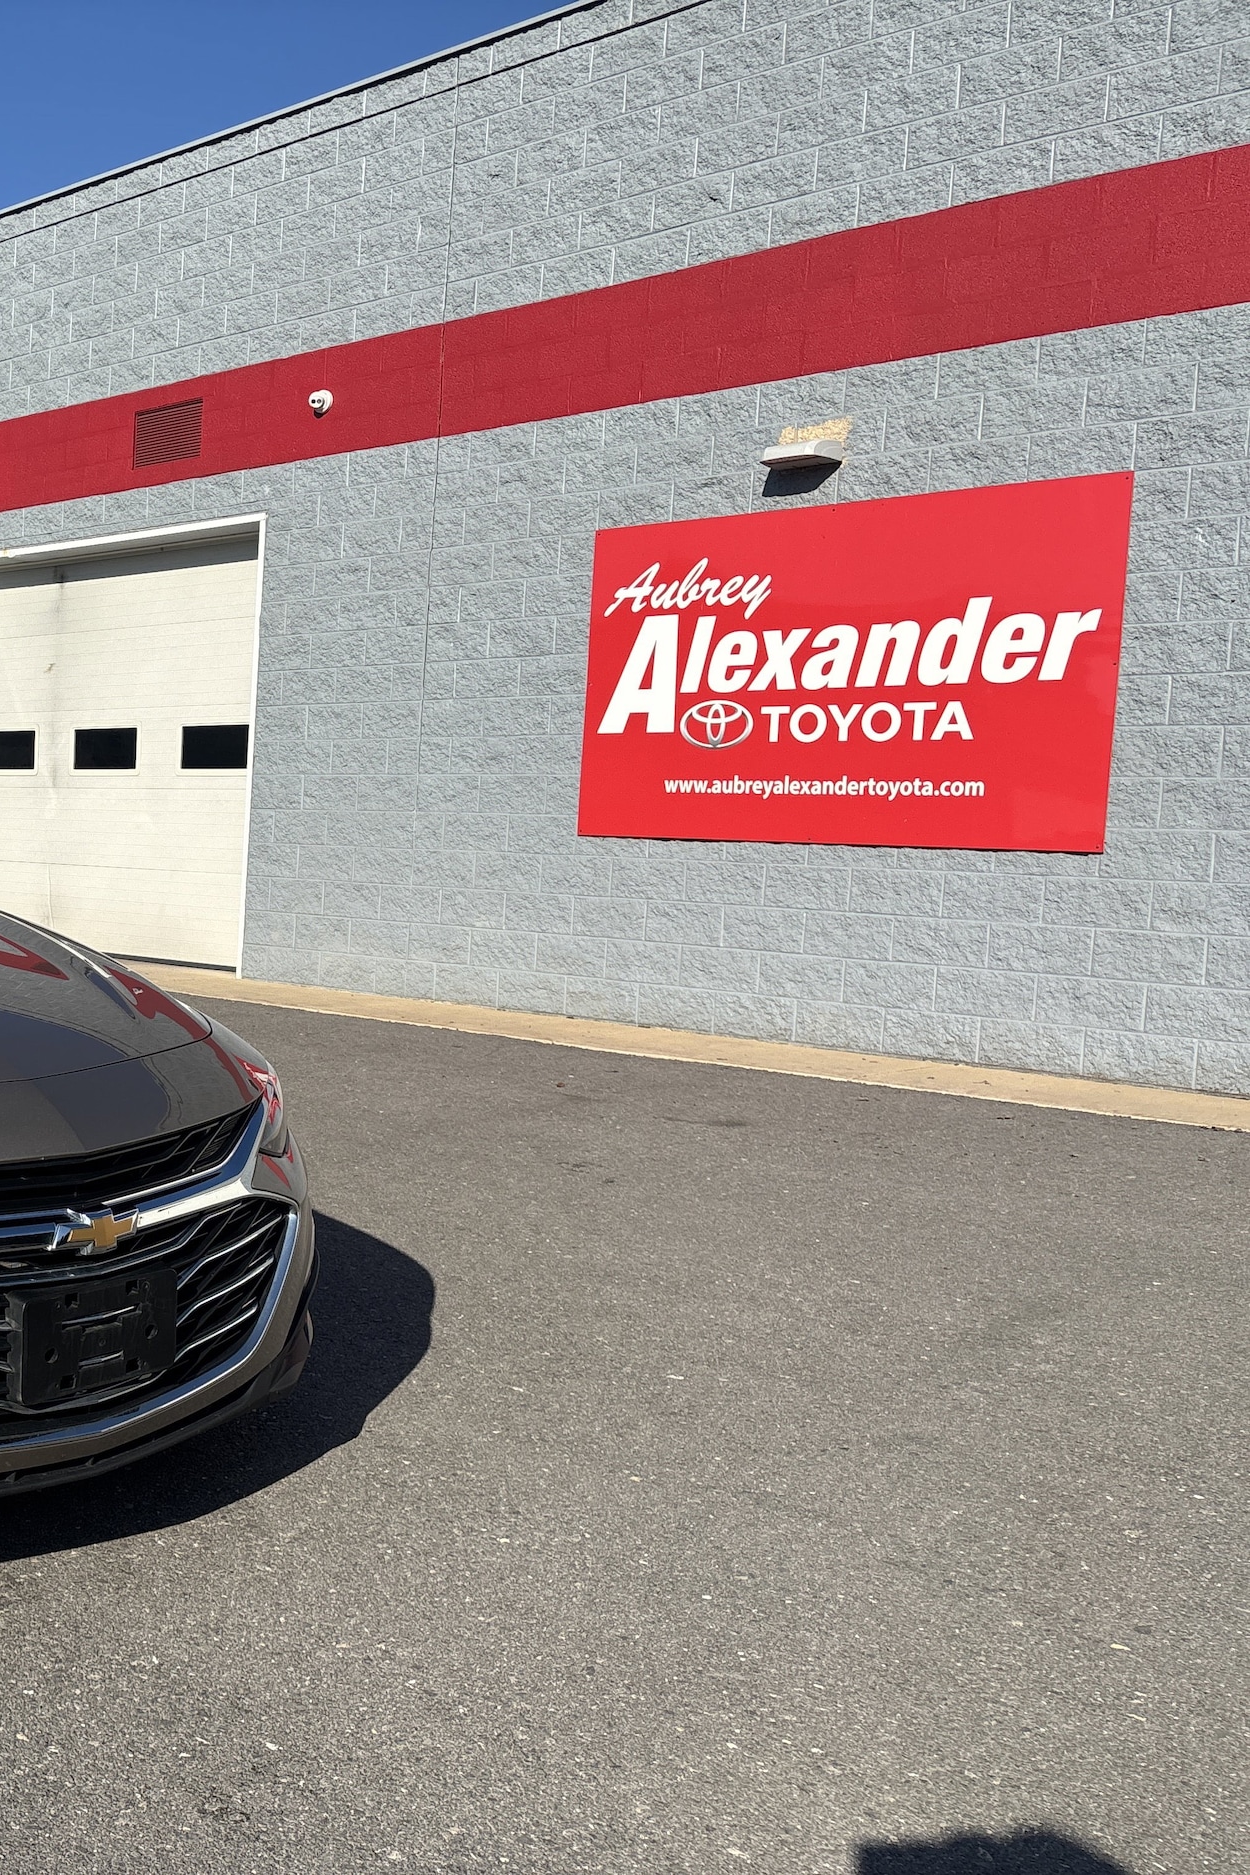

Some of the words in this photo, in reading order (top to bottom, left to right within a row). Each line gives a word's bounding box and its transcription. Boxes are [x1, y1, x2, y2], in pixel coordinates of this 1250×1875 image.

[604, 558, 772, 619] Aubrey
[597, 596, 1103, 734] Alexander
[761, 701, 974, 743] TOYOTA
[664, 775, 985, 801] www.aubreyalexandertoyota.com
